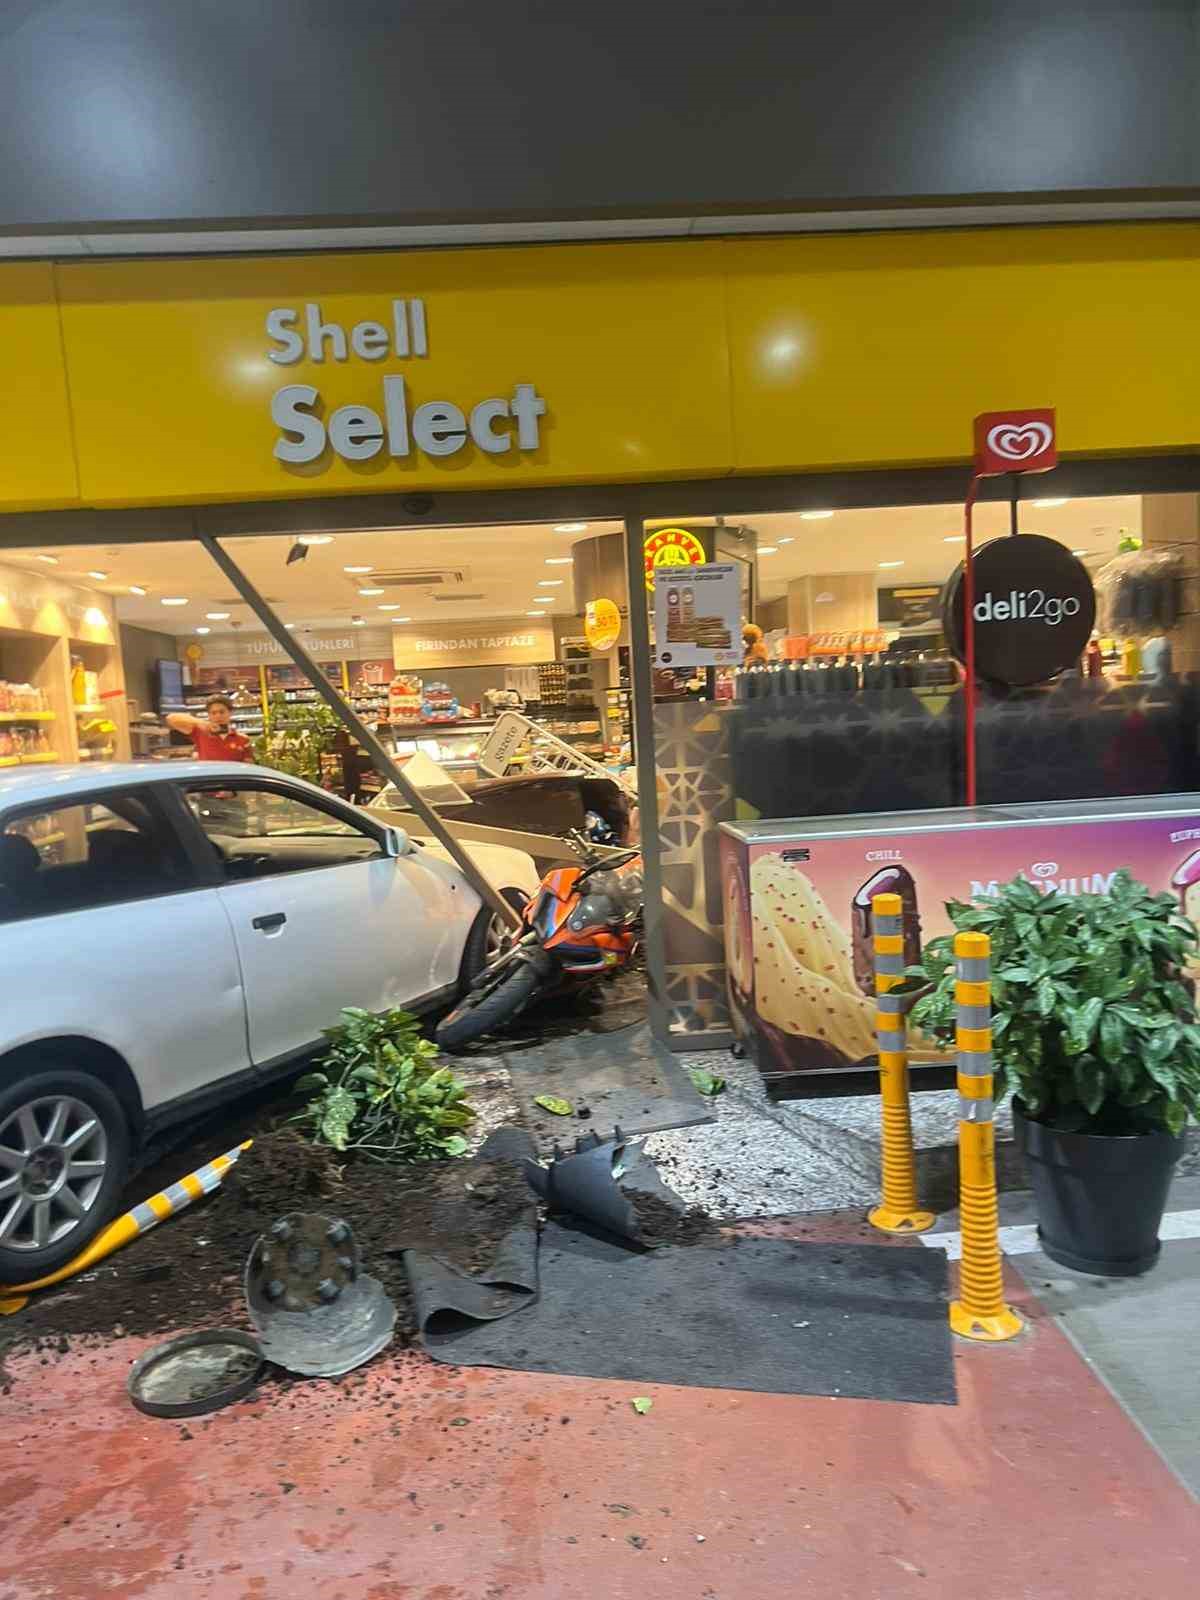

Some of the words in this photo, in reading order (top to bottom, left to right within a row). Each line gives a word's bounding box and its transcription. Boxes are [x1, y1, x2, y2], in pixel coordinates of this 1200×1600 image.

[266, 298, 428, 364] Shell
[271, 374, 547, 464] Select
[973, 589, 1080, 625] deli2go
[480, 634, 536, 648] TAPTAZE
[865, 849, 903, 861] CHILL
